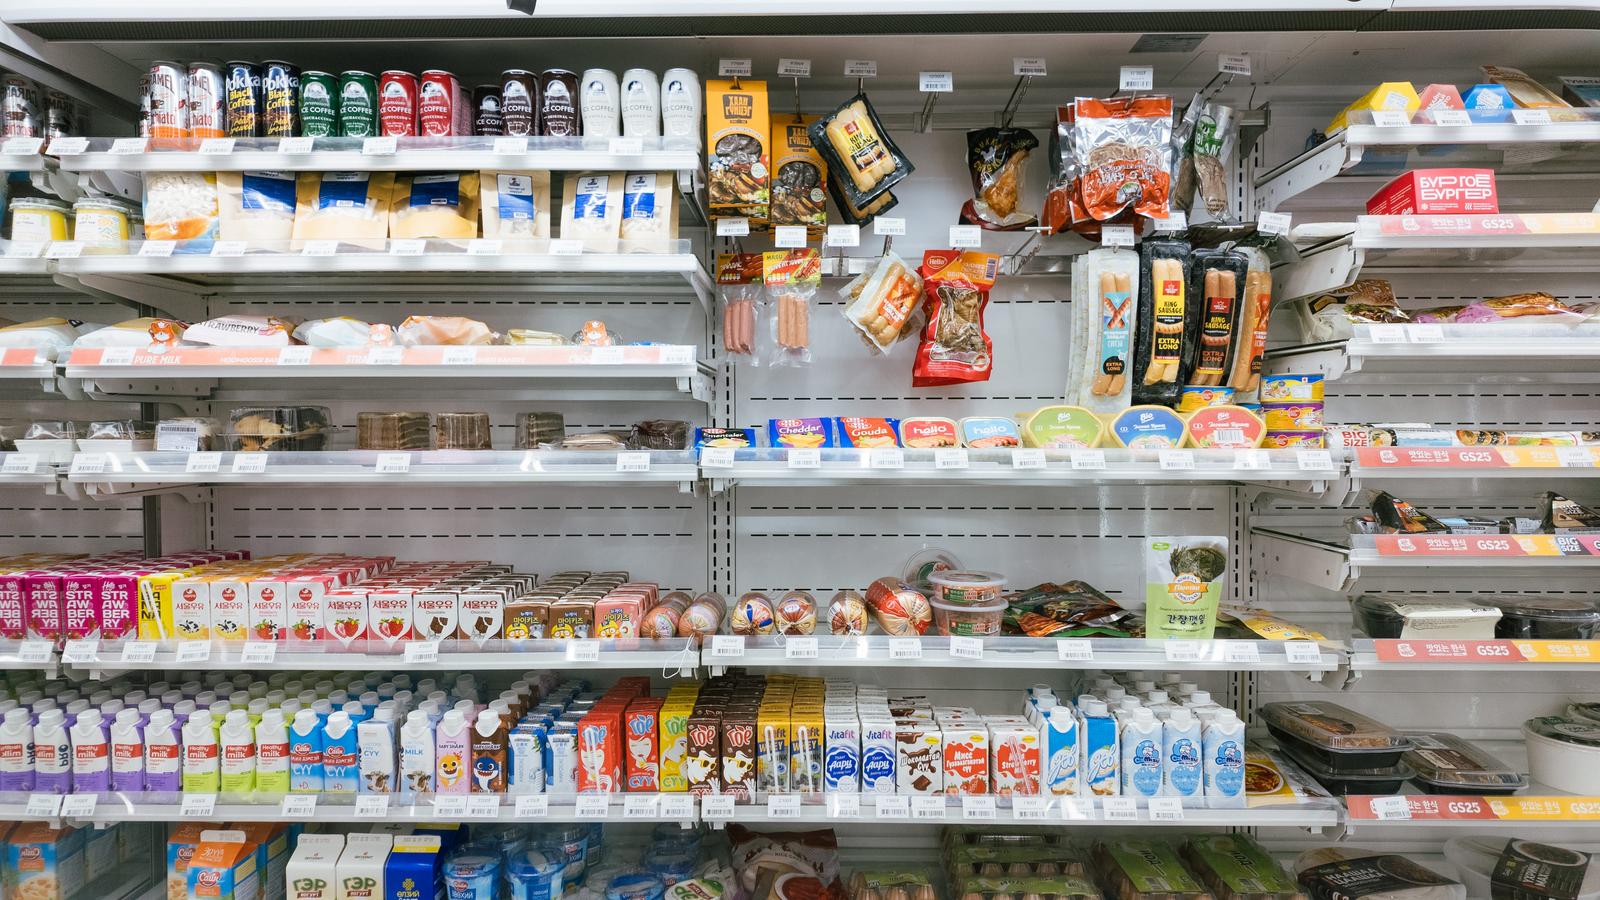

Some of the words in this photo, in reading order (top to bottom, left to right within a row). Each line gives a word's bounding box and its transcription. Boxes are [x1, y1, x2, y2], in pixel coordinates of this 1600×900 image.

[229, 87, 253, 99] Black
[268, 88, 292, 100] Black
[228, 98, 256, 111] Coffee
[266, 99, 295, 112] Coffee
[309, 107, 335, 116] COFFEE
[348, 106, 372, 115] COFFEE
[388, 106, 412, 115] COFFEE
[424, 106, 447, 115] COFFEE
[508, 105, 532, 114] COFFEE
[550, 106, 574, 114] COFFEE
[1420, 188, 1492, 201] БУРГЕР
[1482, 219, 1514, 229] GS25
[1158, 307, 1182, 315] SAUSAGE
[1204, 321, 1231, 330] SAUSAGE
[1202, 350, 1225, 358] EXTRA
[134, 355, 157, 365] PURE
[160, 355, 181, 365] MILK
[779, 425, 821, 434] Cheddar
[851, 427, 888, 436] Gouda
[914, 425, 947, 435] hello
[973, 425, 1007, 435] hello
[1342, 430, 1368, 439] BIG
[1343, 438, 1368, 448] SIZE
[1459, 452, 1491, 463] GS25
[1477, 540, 1510, 550] GS25
[1558, 537, 1578, 546] BIG
[1562, 544, 1582, 552] SIZE
[66, 591, 93, 600] STR
[102, 591, 128, 600] STR
[67, 600, 90, 609] AW
[102, 600, 126, 609] AW
[328, 600, 361, 610] 서울우유
[372, 600, 407, 610] 서울우유
[418, 600, 453, 610] 서울우유
[462, 600, 498, 610] 서울우유
[67, 609, 95, 618] BER
[103, 609, 130, 618] BER
[603, 613, 630, 622] 마이키즈
[67, 618, 85, 628] RY
[103, 618, 119, 628] RY
[513, 616, 540, 624] 마이키즈
[557, 617, 584, 625] 마이키즈
[1477, 645, 1510, 656] GS25
[78, 750, 96, 758] milk
[115, 750, 133, 758] milk
[151, 750, 169, 758] milk
[190, 750, 208, 758] milk
[228, 750, 245, 758] milk
[262, 750, 281, 758] milk
[1449, 802, 1481, 813] GS25
[292, 877, 327, 891] ГЭР
[342, 876, 377, 890] ГЭР
